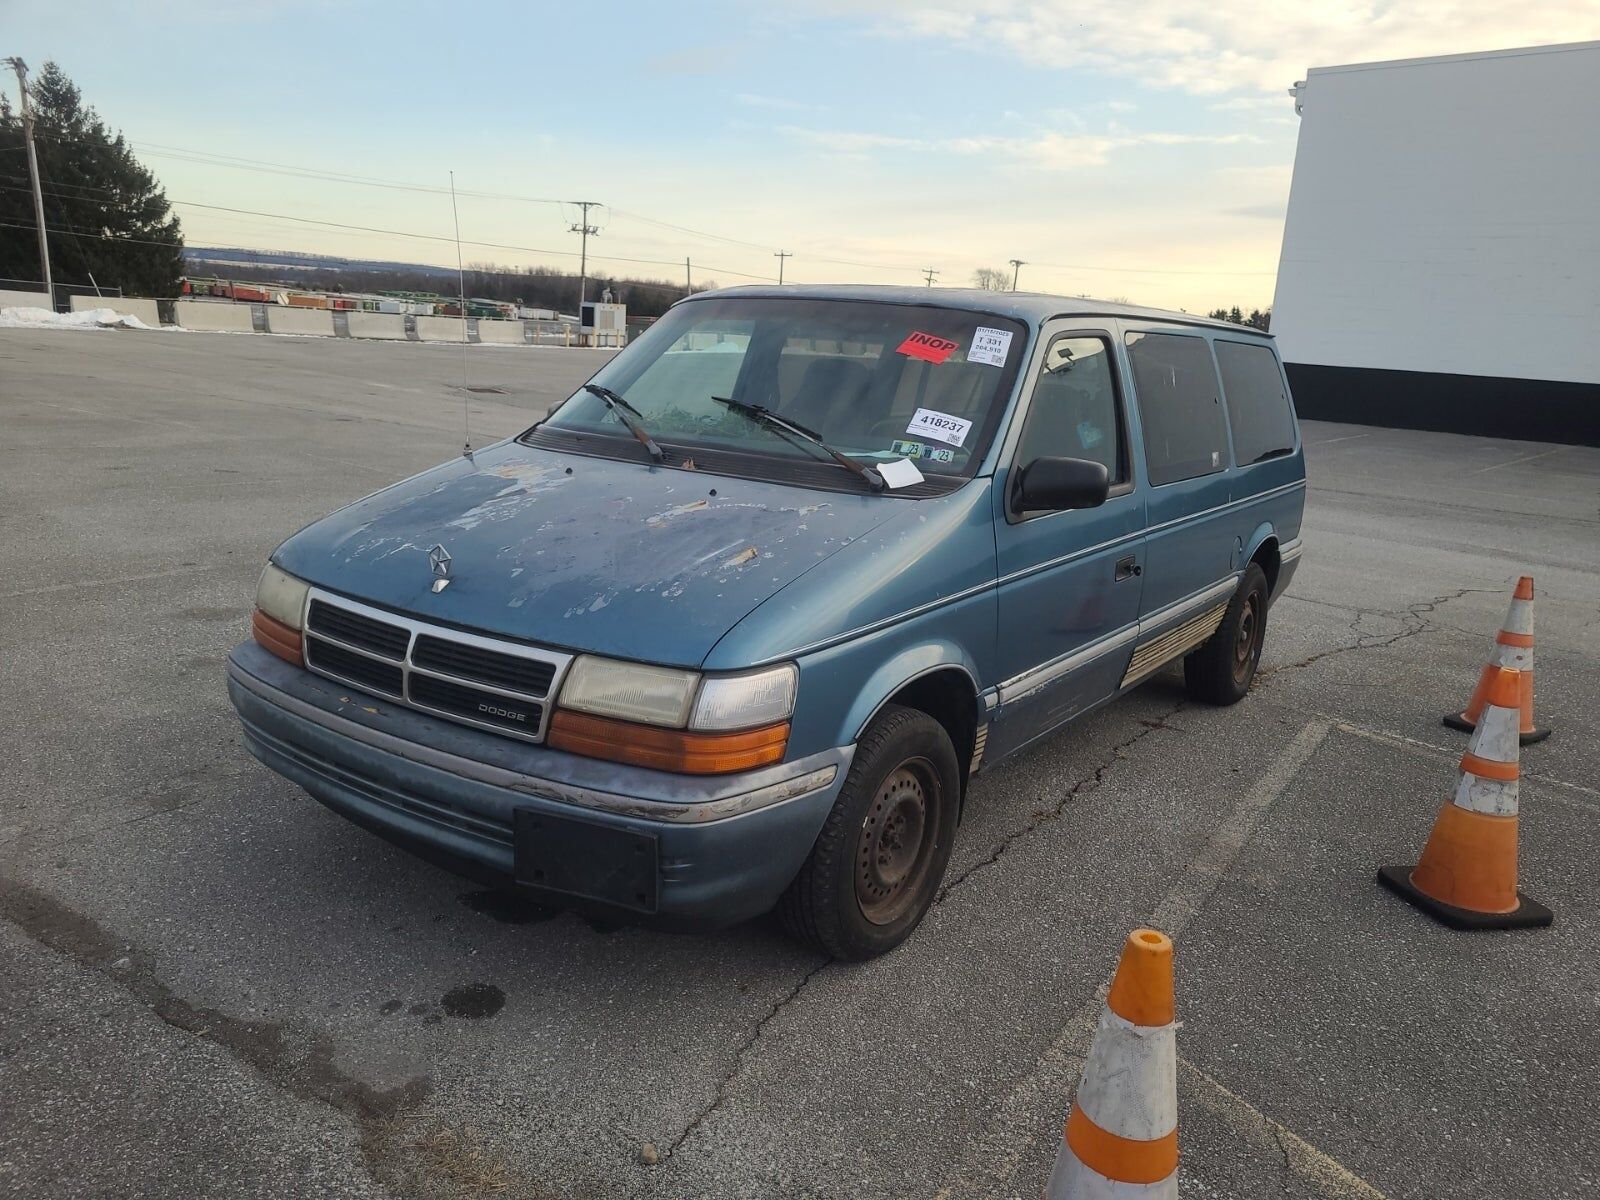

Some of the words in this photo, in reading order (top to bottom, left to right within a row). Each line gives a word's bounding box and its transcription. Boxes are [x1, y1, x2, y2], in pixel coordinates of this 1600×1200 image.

[910, 333, 956, 351] INOP
[986, 337, 1002, 346] 331
[920, 415, 965, 433] 418237
[939, 450, 950, 462] 23
[478, 703, 526, 721] DODGE
